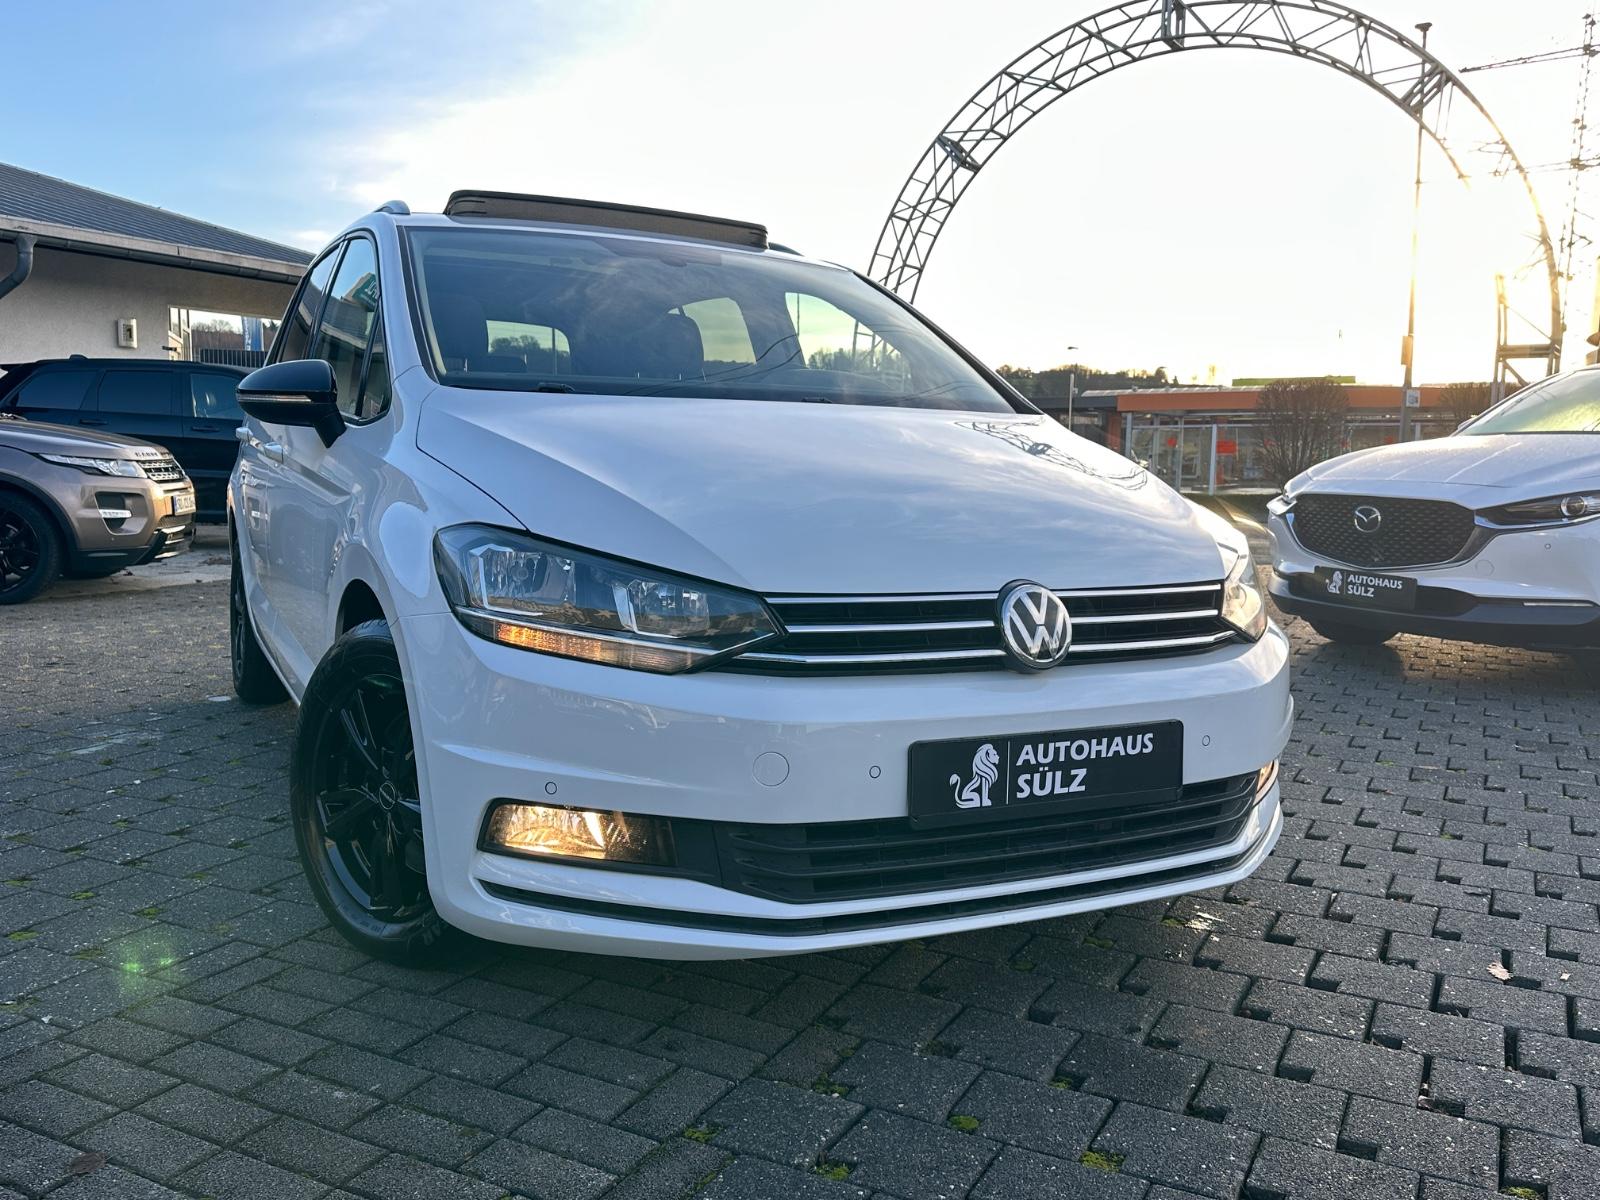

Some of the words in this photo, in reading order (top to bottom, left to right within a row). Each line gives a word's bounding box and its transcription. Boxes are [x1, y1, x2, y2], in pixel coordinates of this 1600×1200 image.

[1347, 574, 1403, 589] AUTOHAUS
[1347, 584, 1375, 597] SÜLZ
[1004, 586, 1070, 661] VW
[1016, 732, 1153, 766] AUTOHAUS
[1016, 766, 1088, 799] SÜLZ
